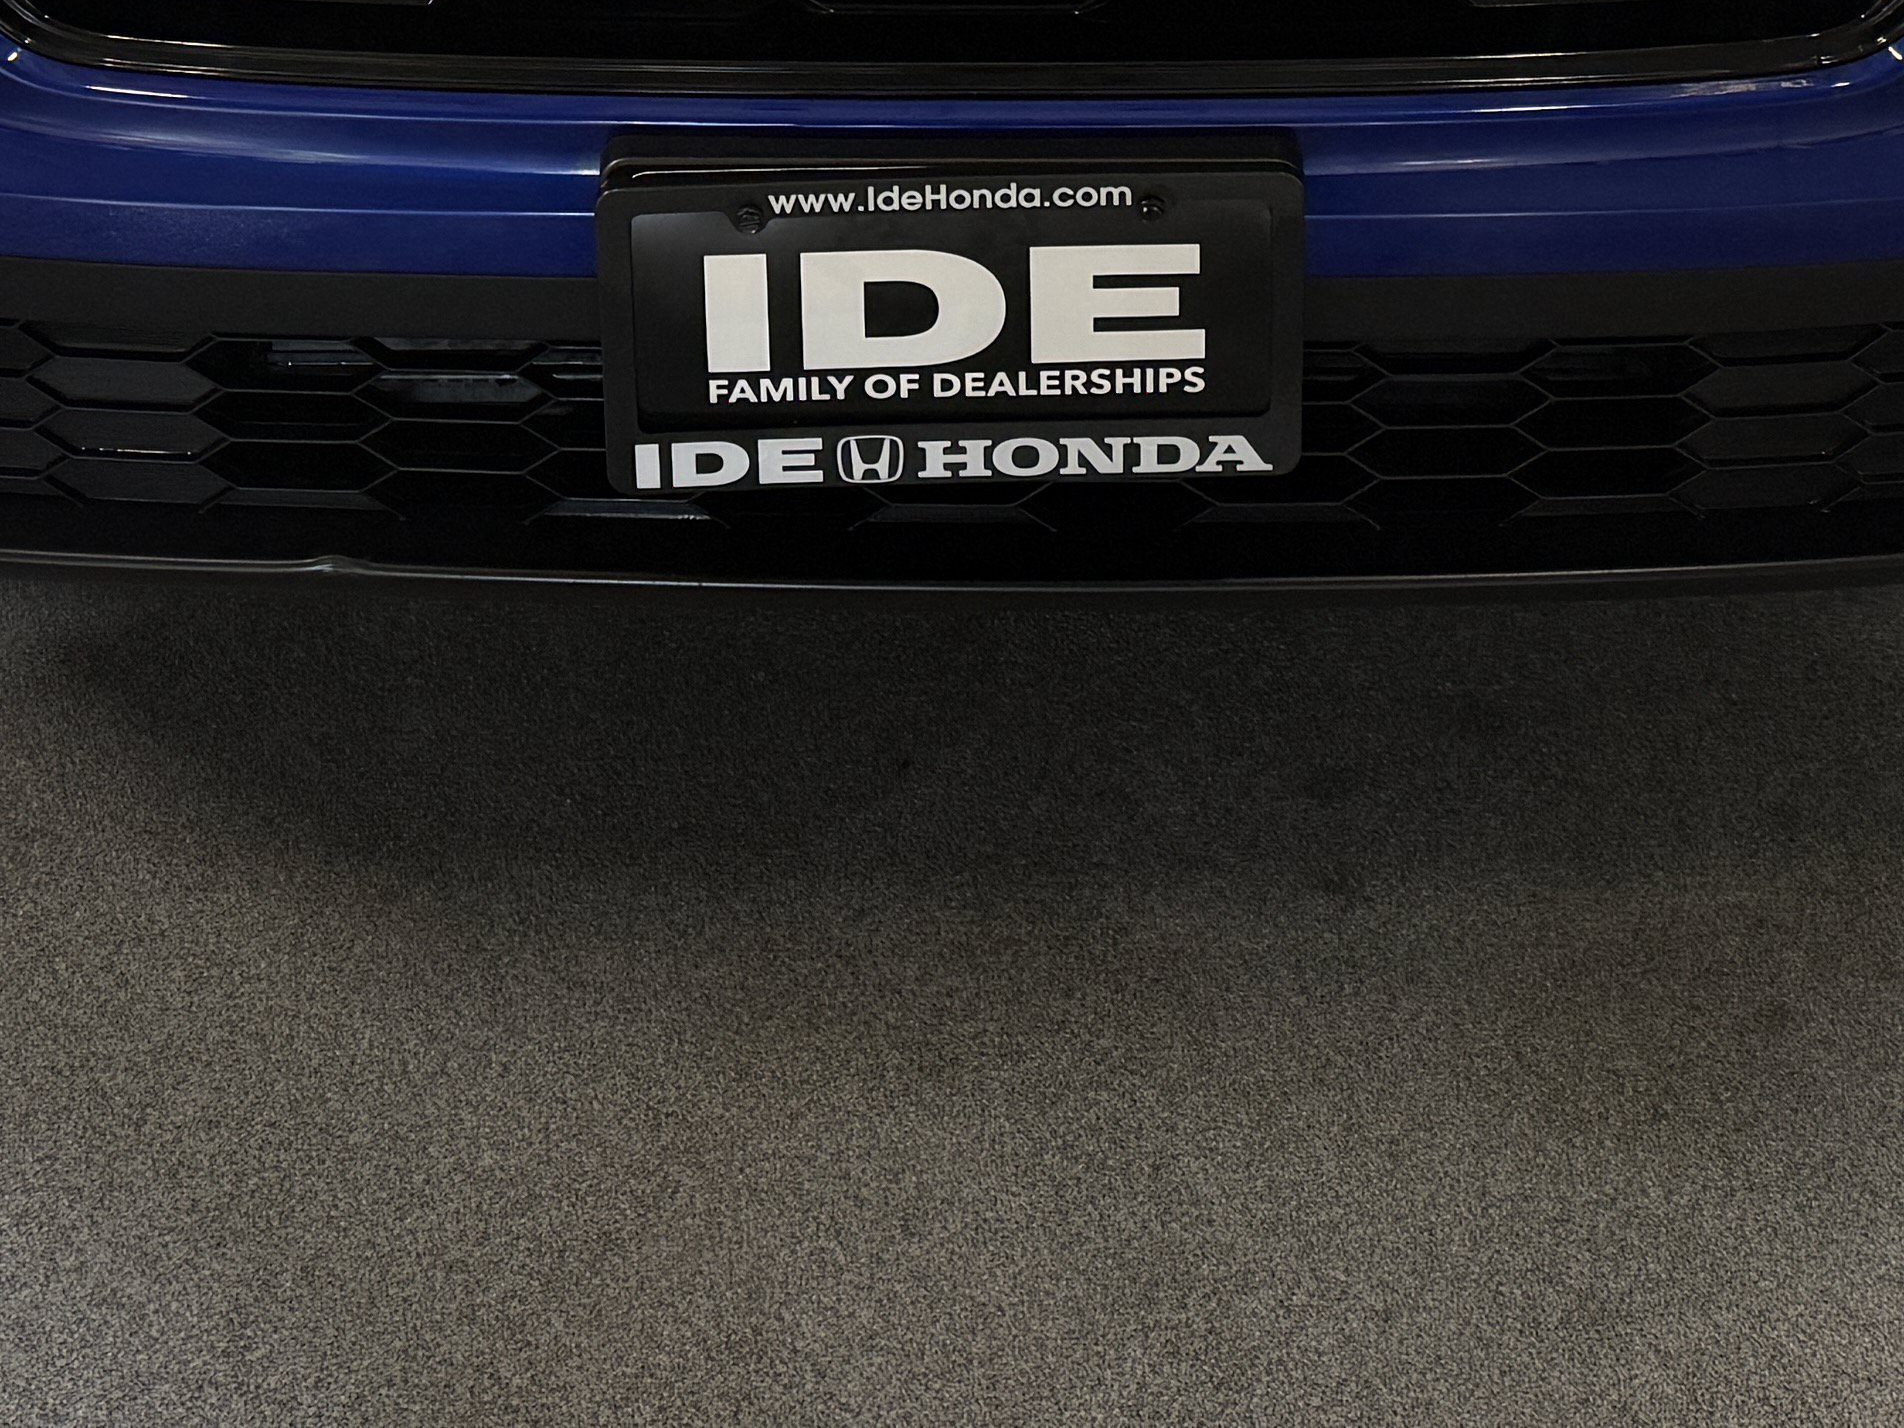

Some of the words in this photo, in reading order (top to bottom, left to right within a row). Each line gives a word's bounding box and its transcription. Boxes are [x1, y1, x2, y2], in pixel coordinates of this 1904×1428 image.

[767, 182, 1132, 216] www.IdeHonda.com
[703, 243, 1207, 374] IDE
[708, 373, 856, 404] FAMILY
[864, 373, 921, 400] OF
[933, 366, 1207, 398] DEALERSHIPS
[634, 437, 825, 489] IDE
[917, 435, 1274, 478] HONDA
